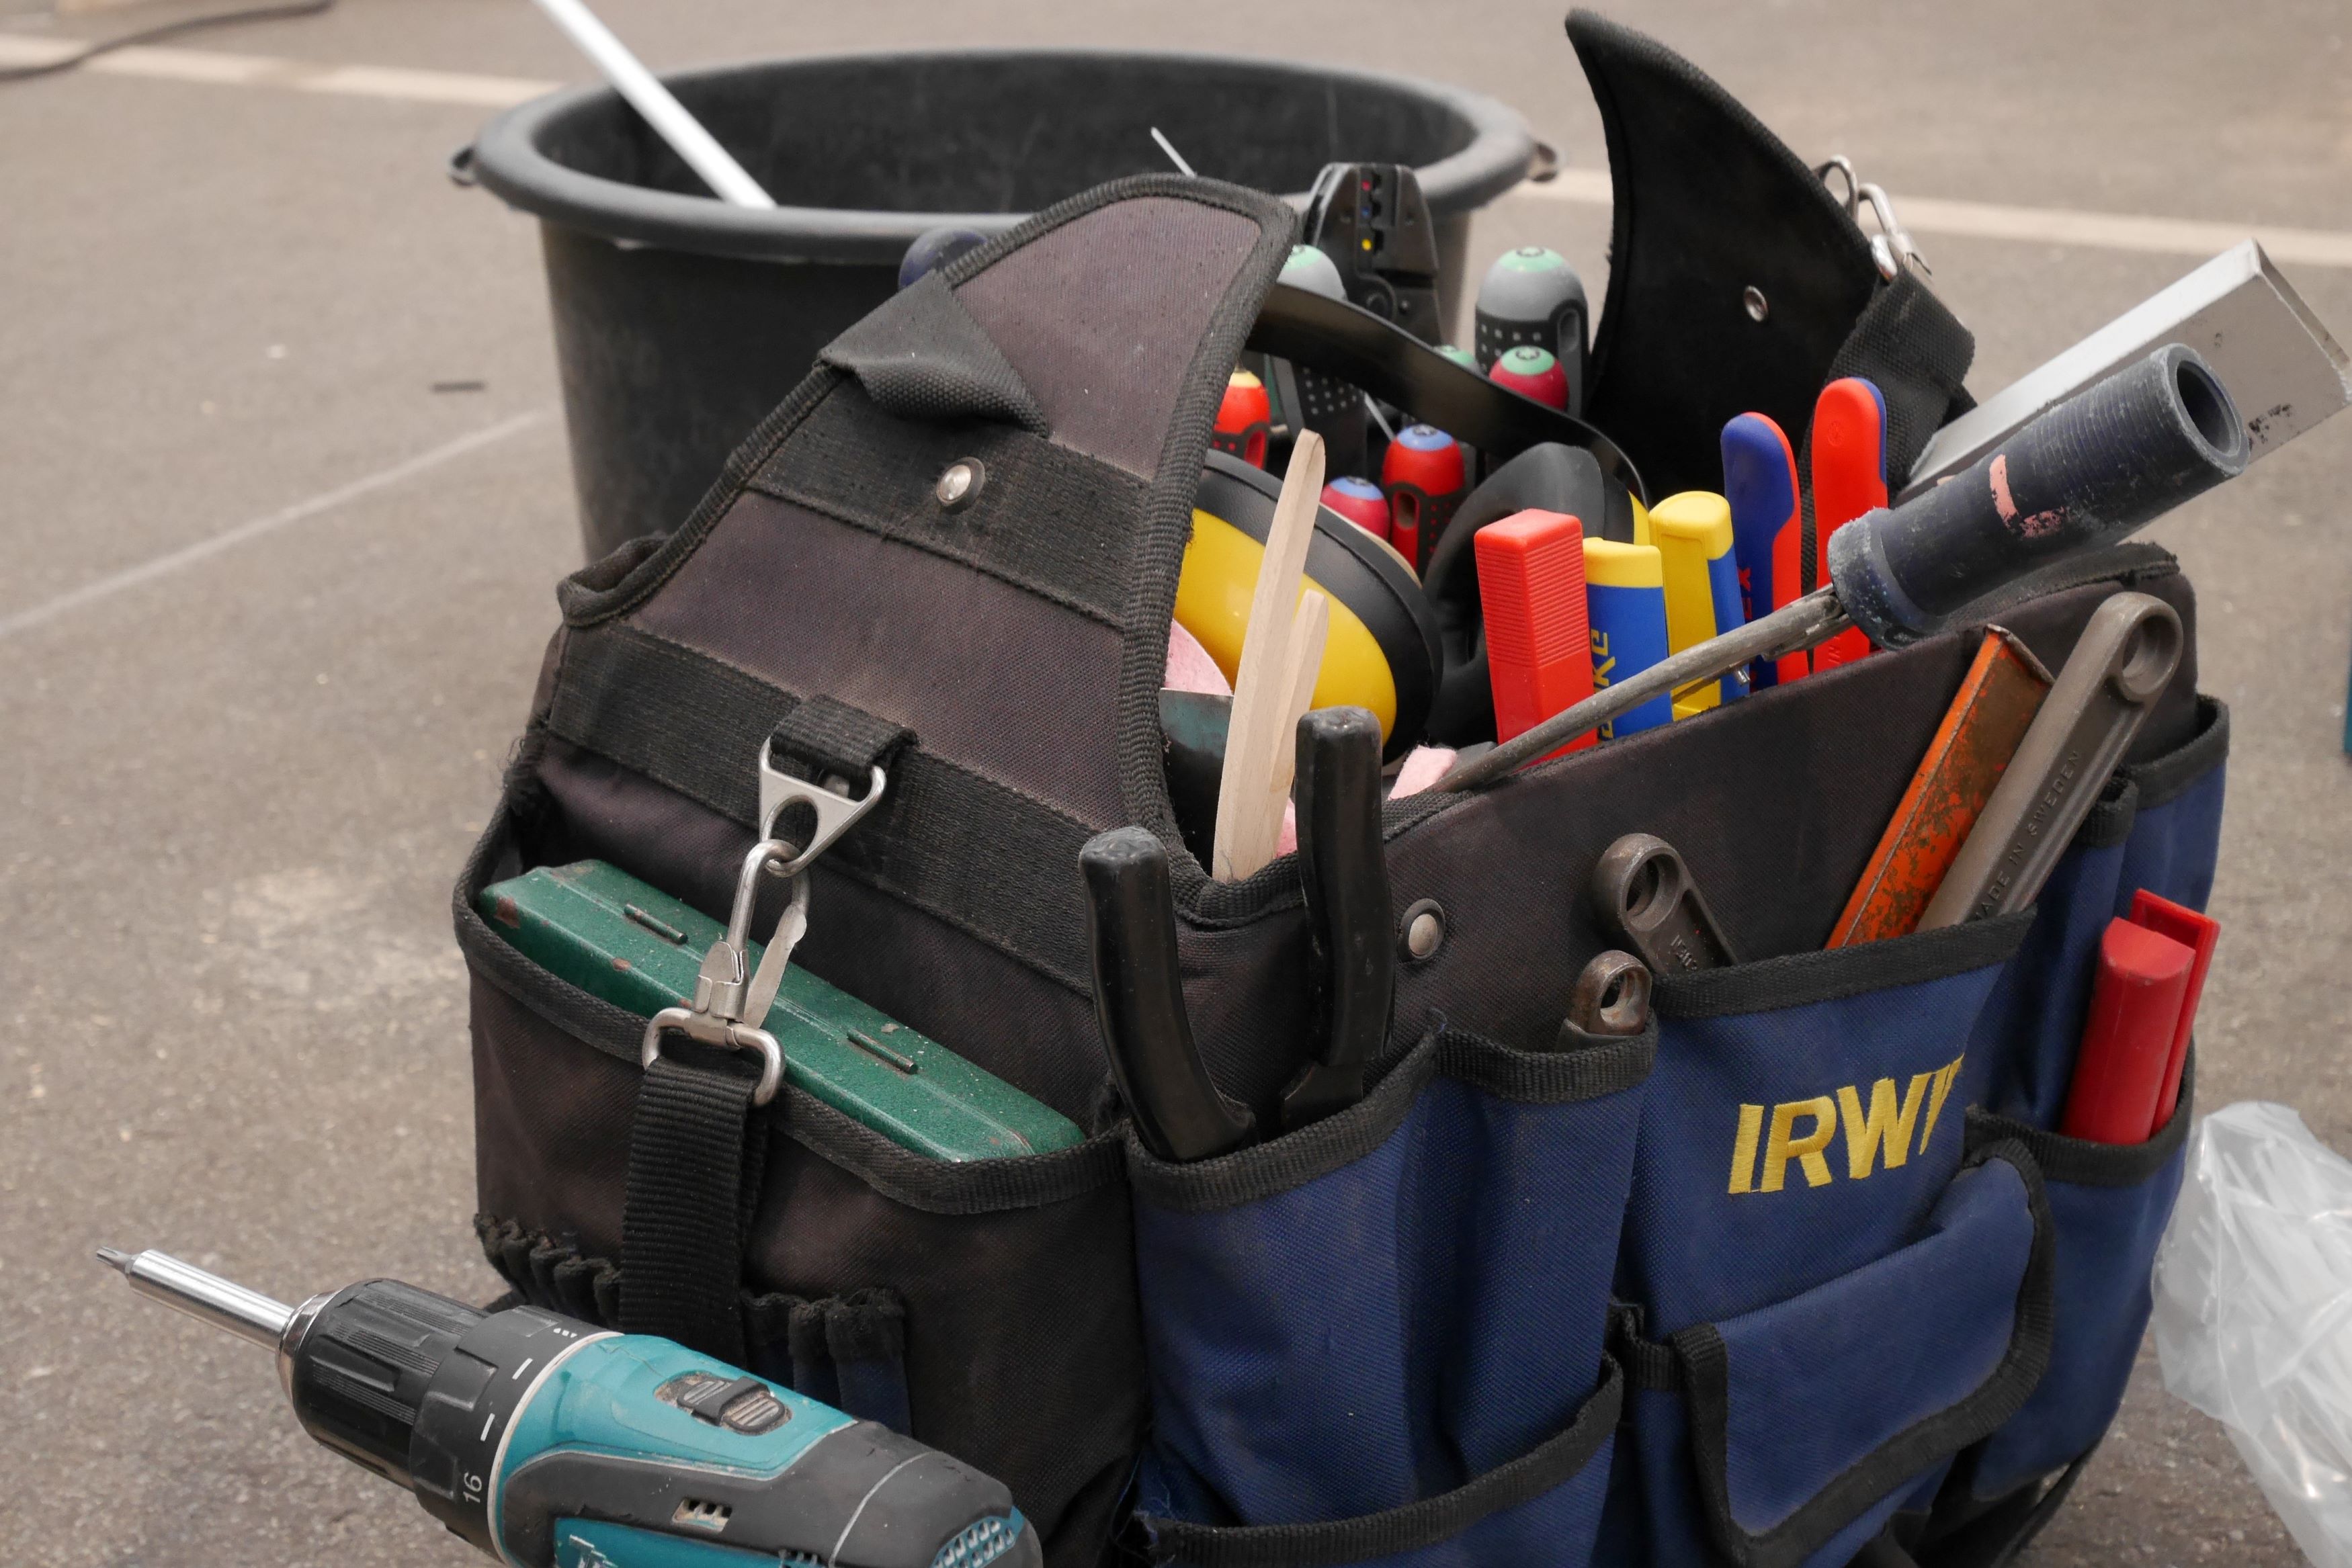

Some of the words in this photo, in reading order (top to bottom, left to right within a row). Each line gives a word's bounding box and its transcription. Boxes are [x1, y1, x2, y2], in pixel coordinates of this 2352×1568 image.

[2009, 842, 2025, 865] IN
[2027, 750, 2083, 836] SWEDEN
[1728, 1053, 1964, 1194] IRWI
[463, 1472, 482, 1504] 16
